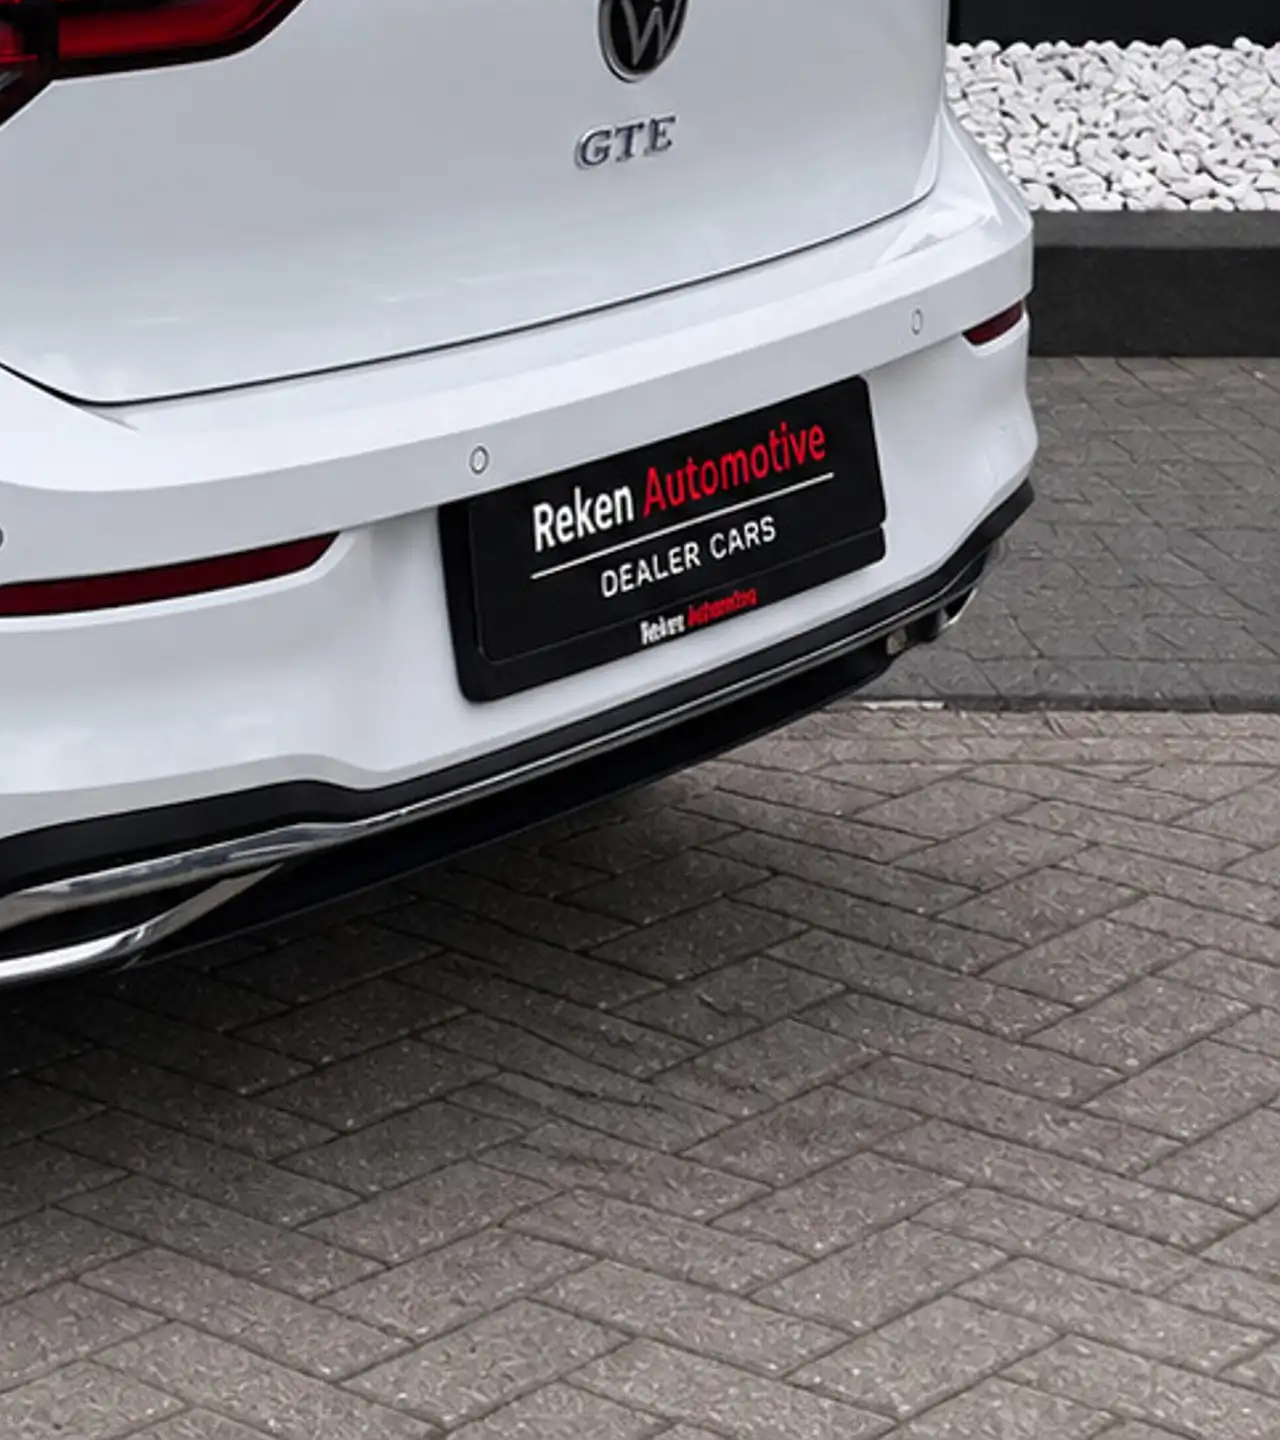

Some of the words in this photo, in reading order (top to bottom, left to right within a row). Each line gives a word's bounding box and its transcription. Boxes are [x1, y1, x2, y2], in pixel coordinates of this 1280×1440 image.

[575, 115, 677, 171] GTE
[532, 485, 635, 553] Reken
[642, 421, 827, 517] Automotive
[600, 541, 703, 598] DEALER
[709, 514, 777, 560] CARS
